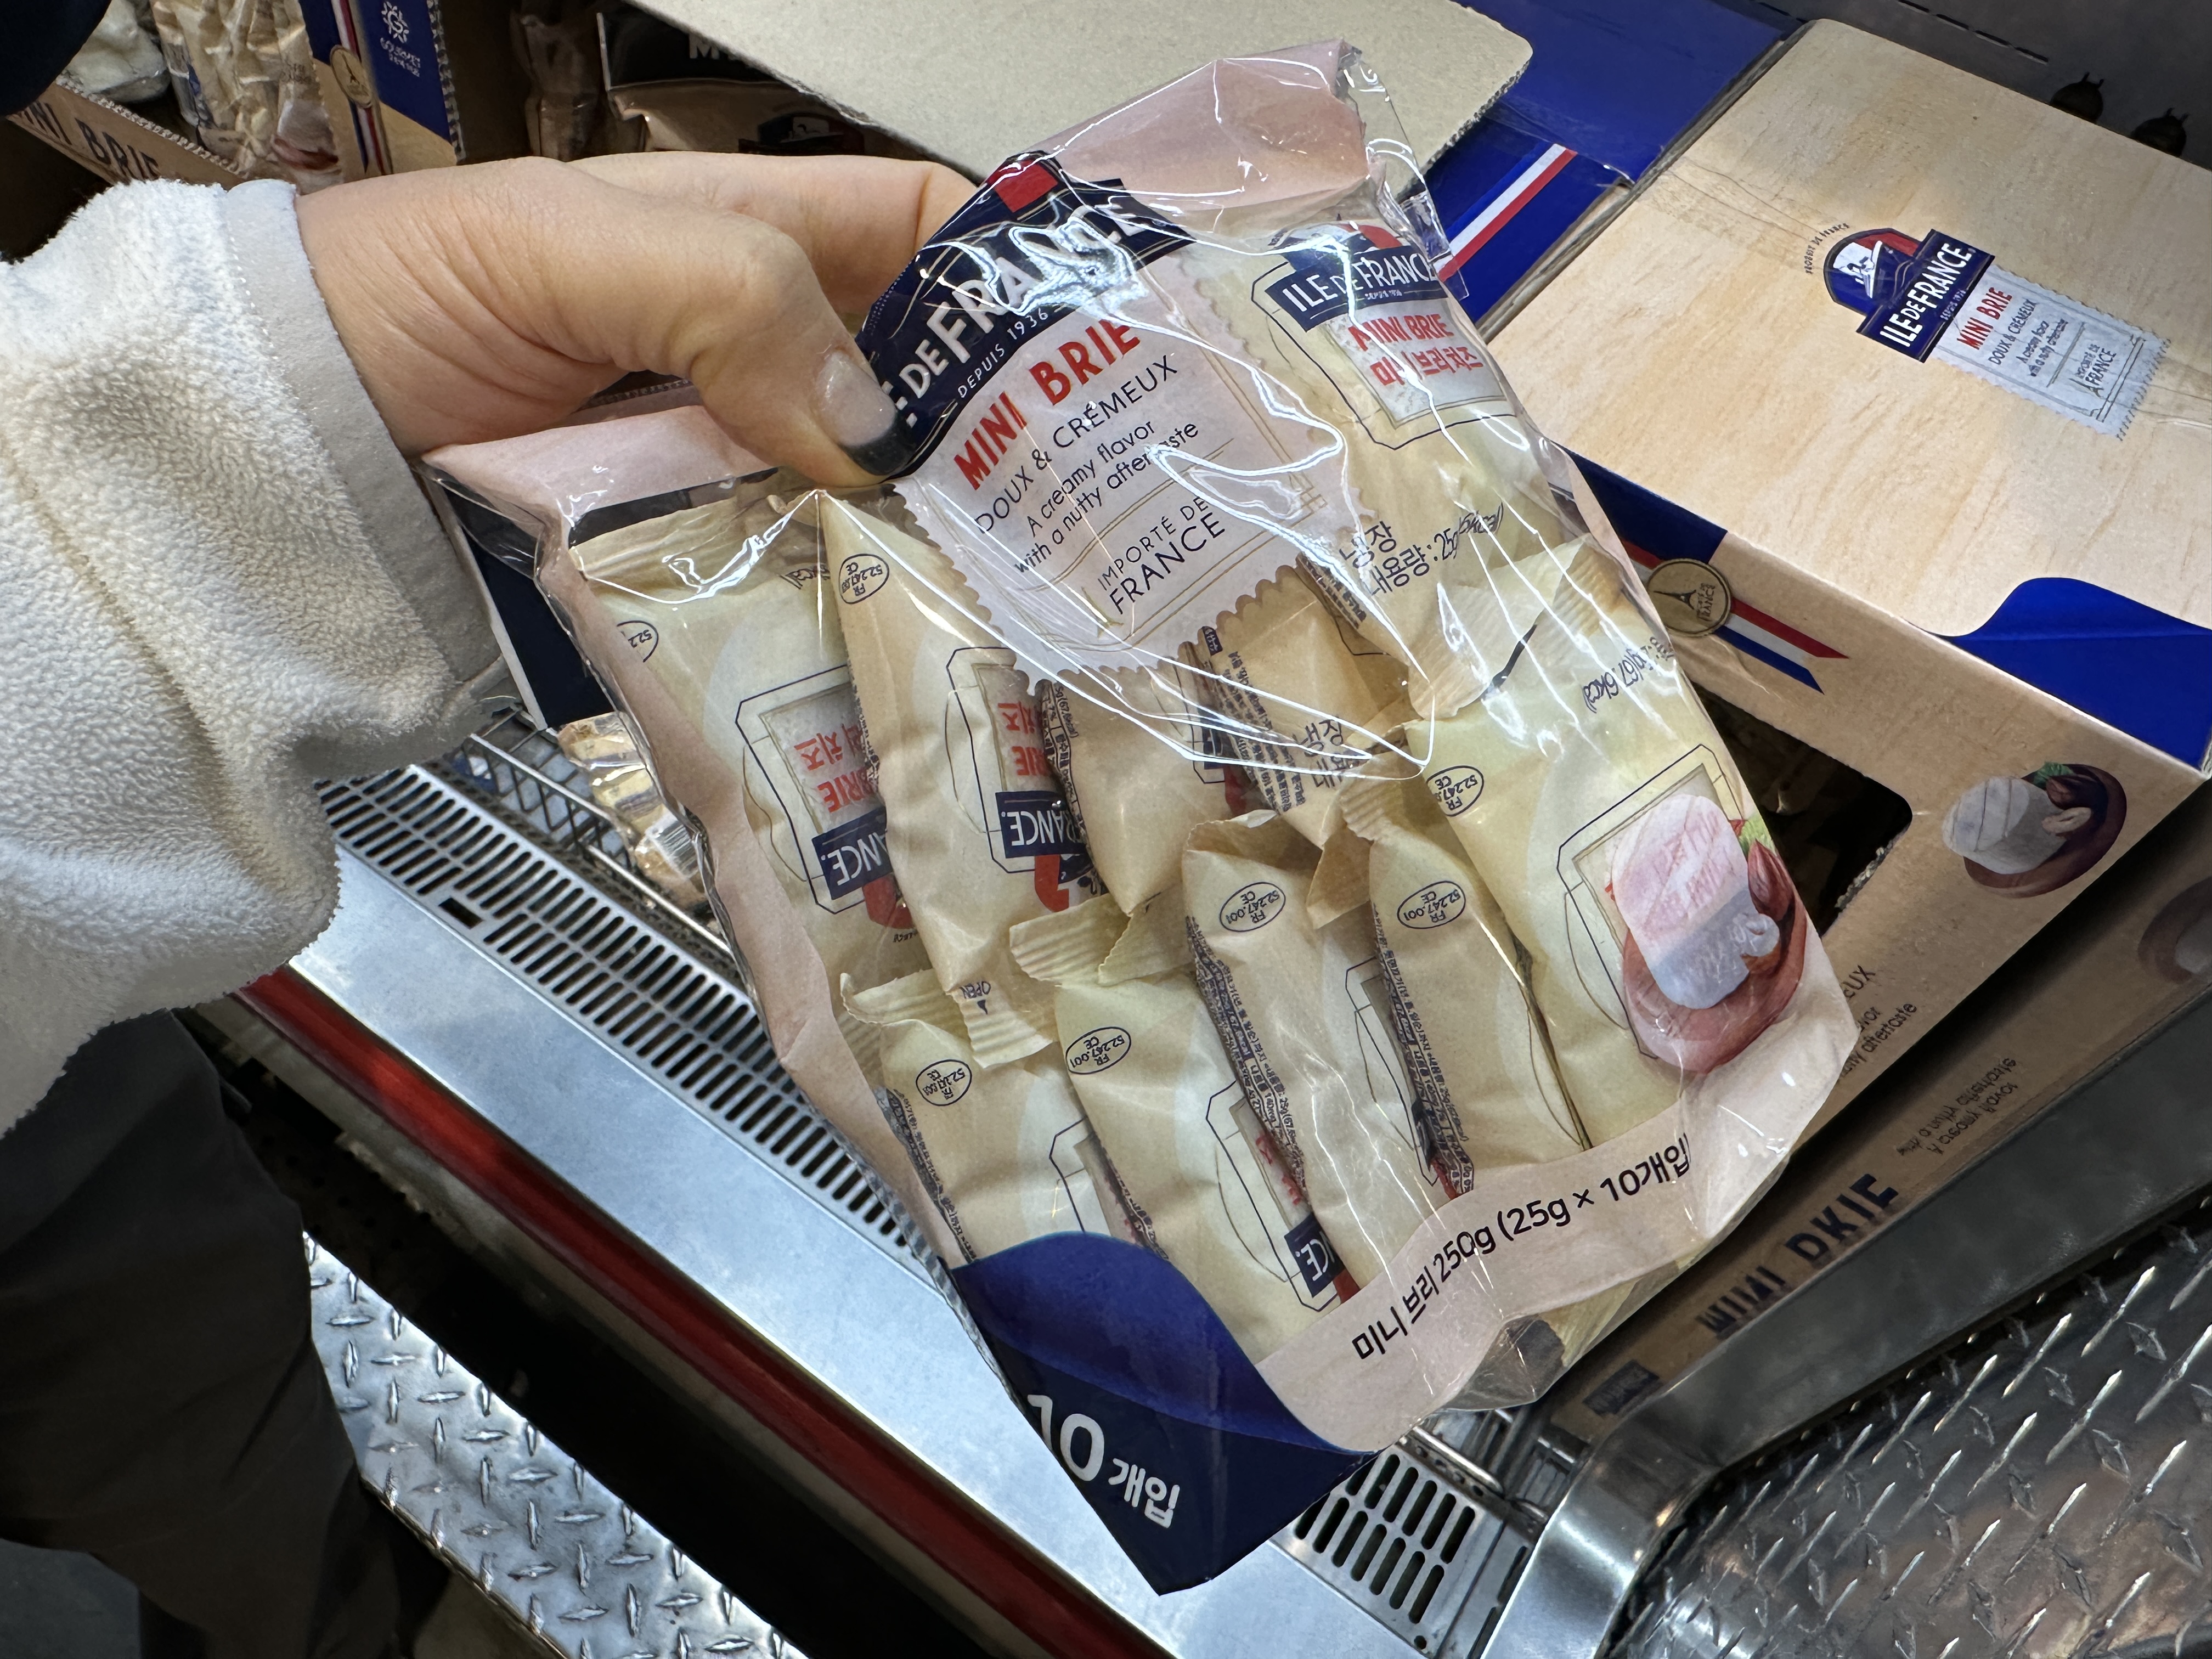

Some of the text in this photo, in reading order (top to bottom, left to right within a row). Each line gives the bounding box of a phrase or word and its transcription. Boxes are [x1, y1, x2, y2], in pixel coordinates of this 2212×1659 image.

[1880, 313, 1923, 348] ILE
[1907, 242, 1973, 309] FRANCE
[1403, 313, 1454, 340] BRIE
[1956, 286, 2013, 351] MINI BRIE
[957, 307, 1048, 398] DEPUIS 1936
[1988, 339, 2013, 365] DOUX
[953, 392, 1028, 490] MINI
[1029, 319, 1141, 405] BRIE
[974, 354, 1178, 535] DOUX & CRÉMEUX
[1014, 422, 1200, 574] with a nutty afteraste
[1027, 419, 1156, 538] A creamy flavor
[1098, 496, 1210, 592] IMPORTÉ DE
[1108, 511, 1227, 615] FRANCE
[1435, 775, 1452, 790] CE
[1446, 796, 1463, 811] FR
[1240, 891, 1256, 905] CE
[1251, 910, 1267, 924] FR
[1420, 891, 1437, 905] CE
[1430, 910, 1446, 923] FR
[1083, 1036, 1099, 1050] CE
[1093, 1053, 1111, 1066] FR
[1433, 1225, 1497, 1283] 250g
[1496, 1198, 1571, 1242] (25g
